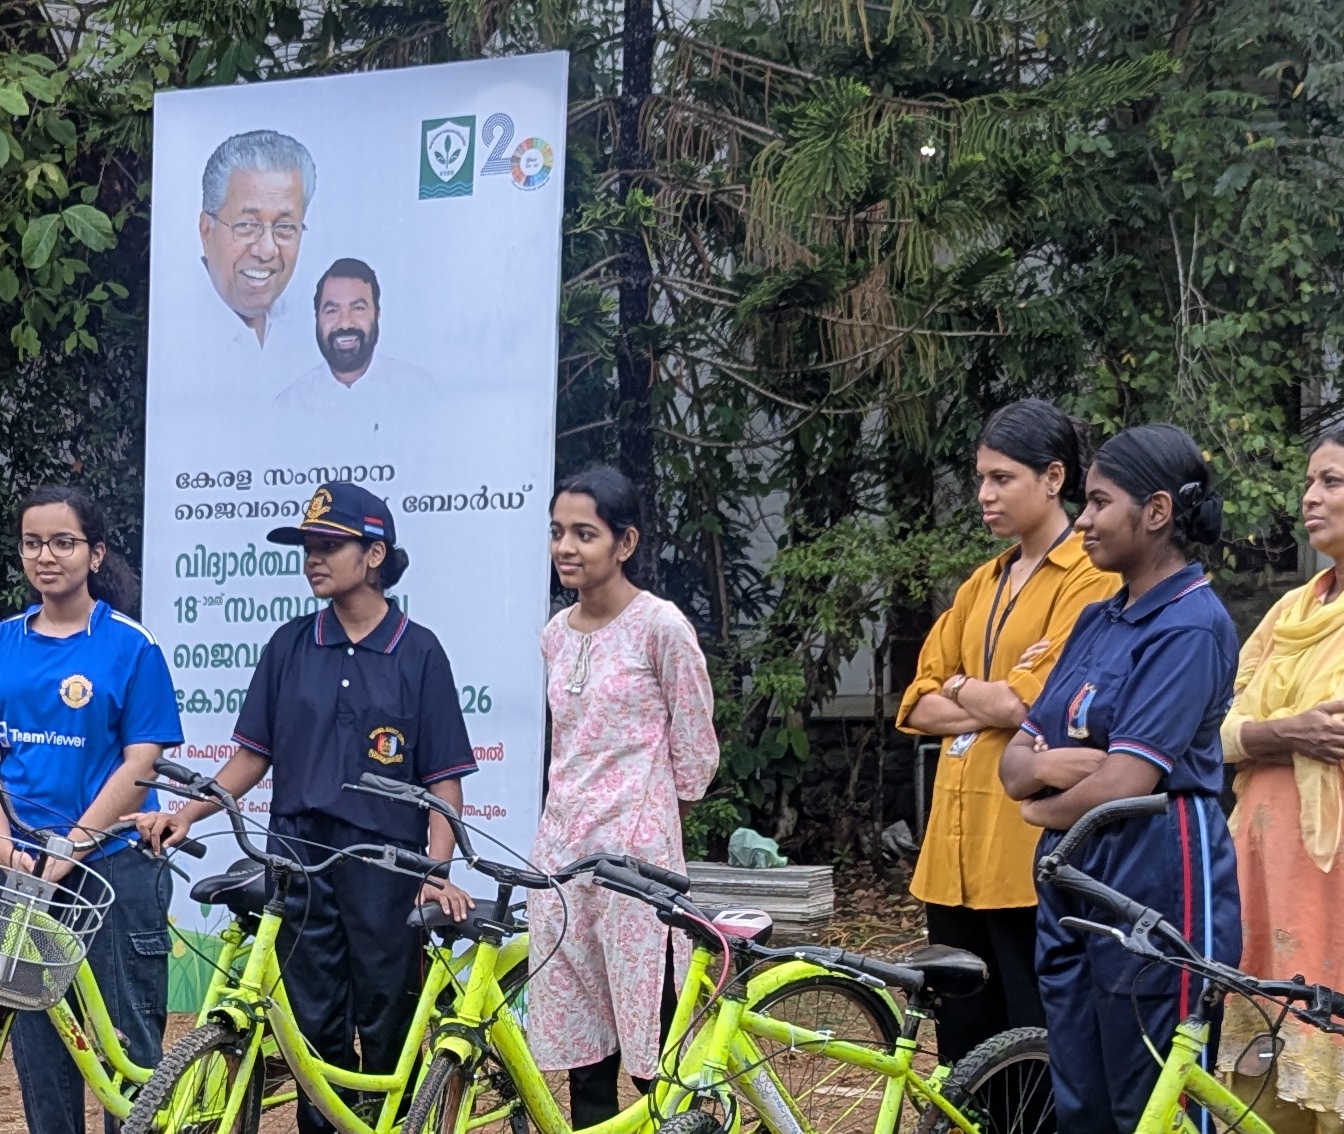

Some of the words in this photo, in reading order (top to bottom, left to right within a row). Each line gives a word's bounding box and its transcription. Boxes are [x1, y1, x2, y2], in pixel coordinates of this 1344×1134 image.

[175, 469, 253, 491] കേരള
[402, 483, 534, 513] ബോർഡ്
[9, 728, 86, 748] TeamViewer
